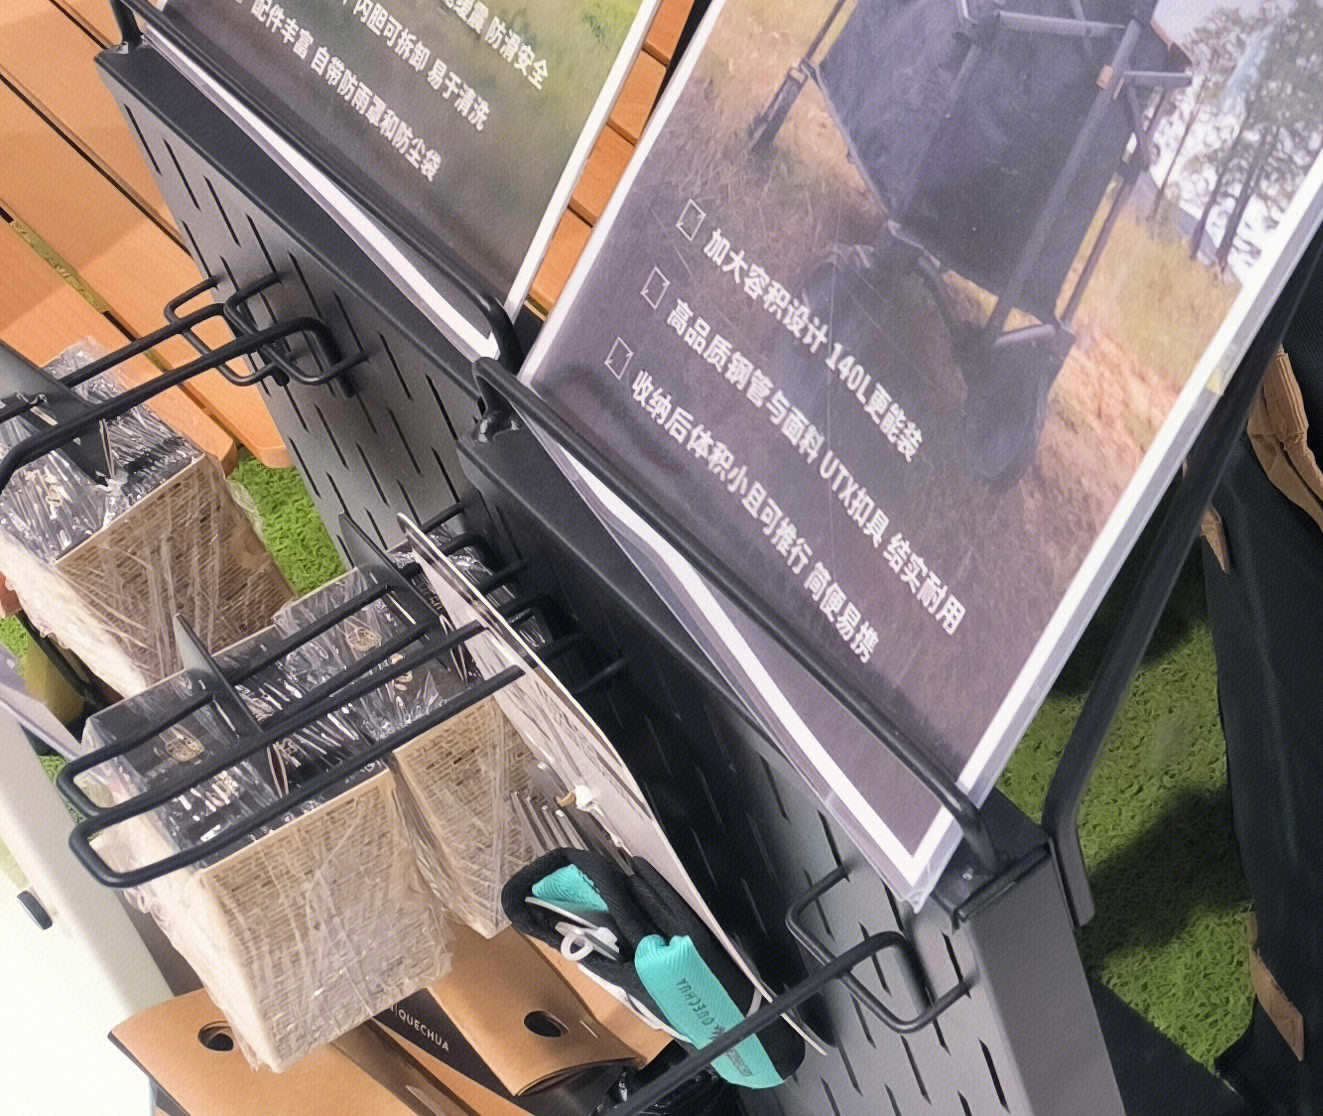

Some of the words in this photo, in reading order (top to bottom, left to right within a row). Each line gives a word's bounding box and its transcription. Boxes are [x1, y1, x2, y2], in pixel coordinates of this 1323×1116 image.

[427, 58, 490, 132] 易于清洗
[485, 16, 549, 91] 防滑安全
[310, 45, 442, 183] 自带防雨罩和防尘袋
[703, 227, 829, 354] 加大容积设计
[824, 342, 924, 462] 140L更能装
[631, 369, 812, 575] 收纳后体积小且可推行
[803, 561, 880, 664] 简便易携
[667, 297, 825, 465] 高品质钢管与面料
[819, 449, 891, 548] UTX扣具
[882, 531, 967, 637] 结实耐用
[398, 1009, 450, 1052] QUECHUA
[677, 978, 715, 1026] QUECHUA
